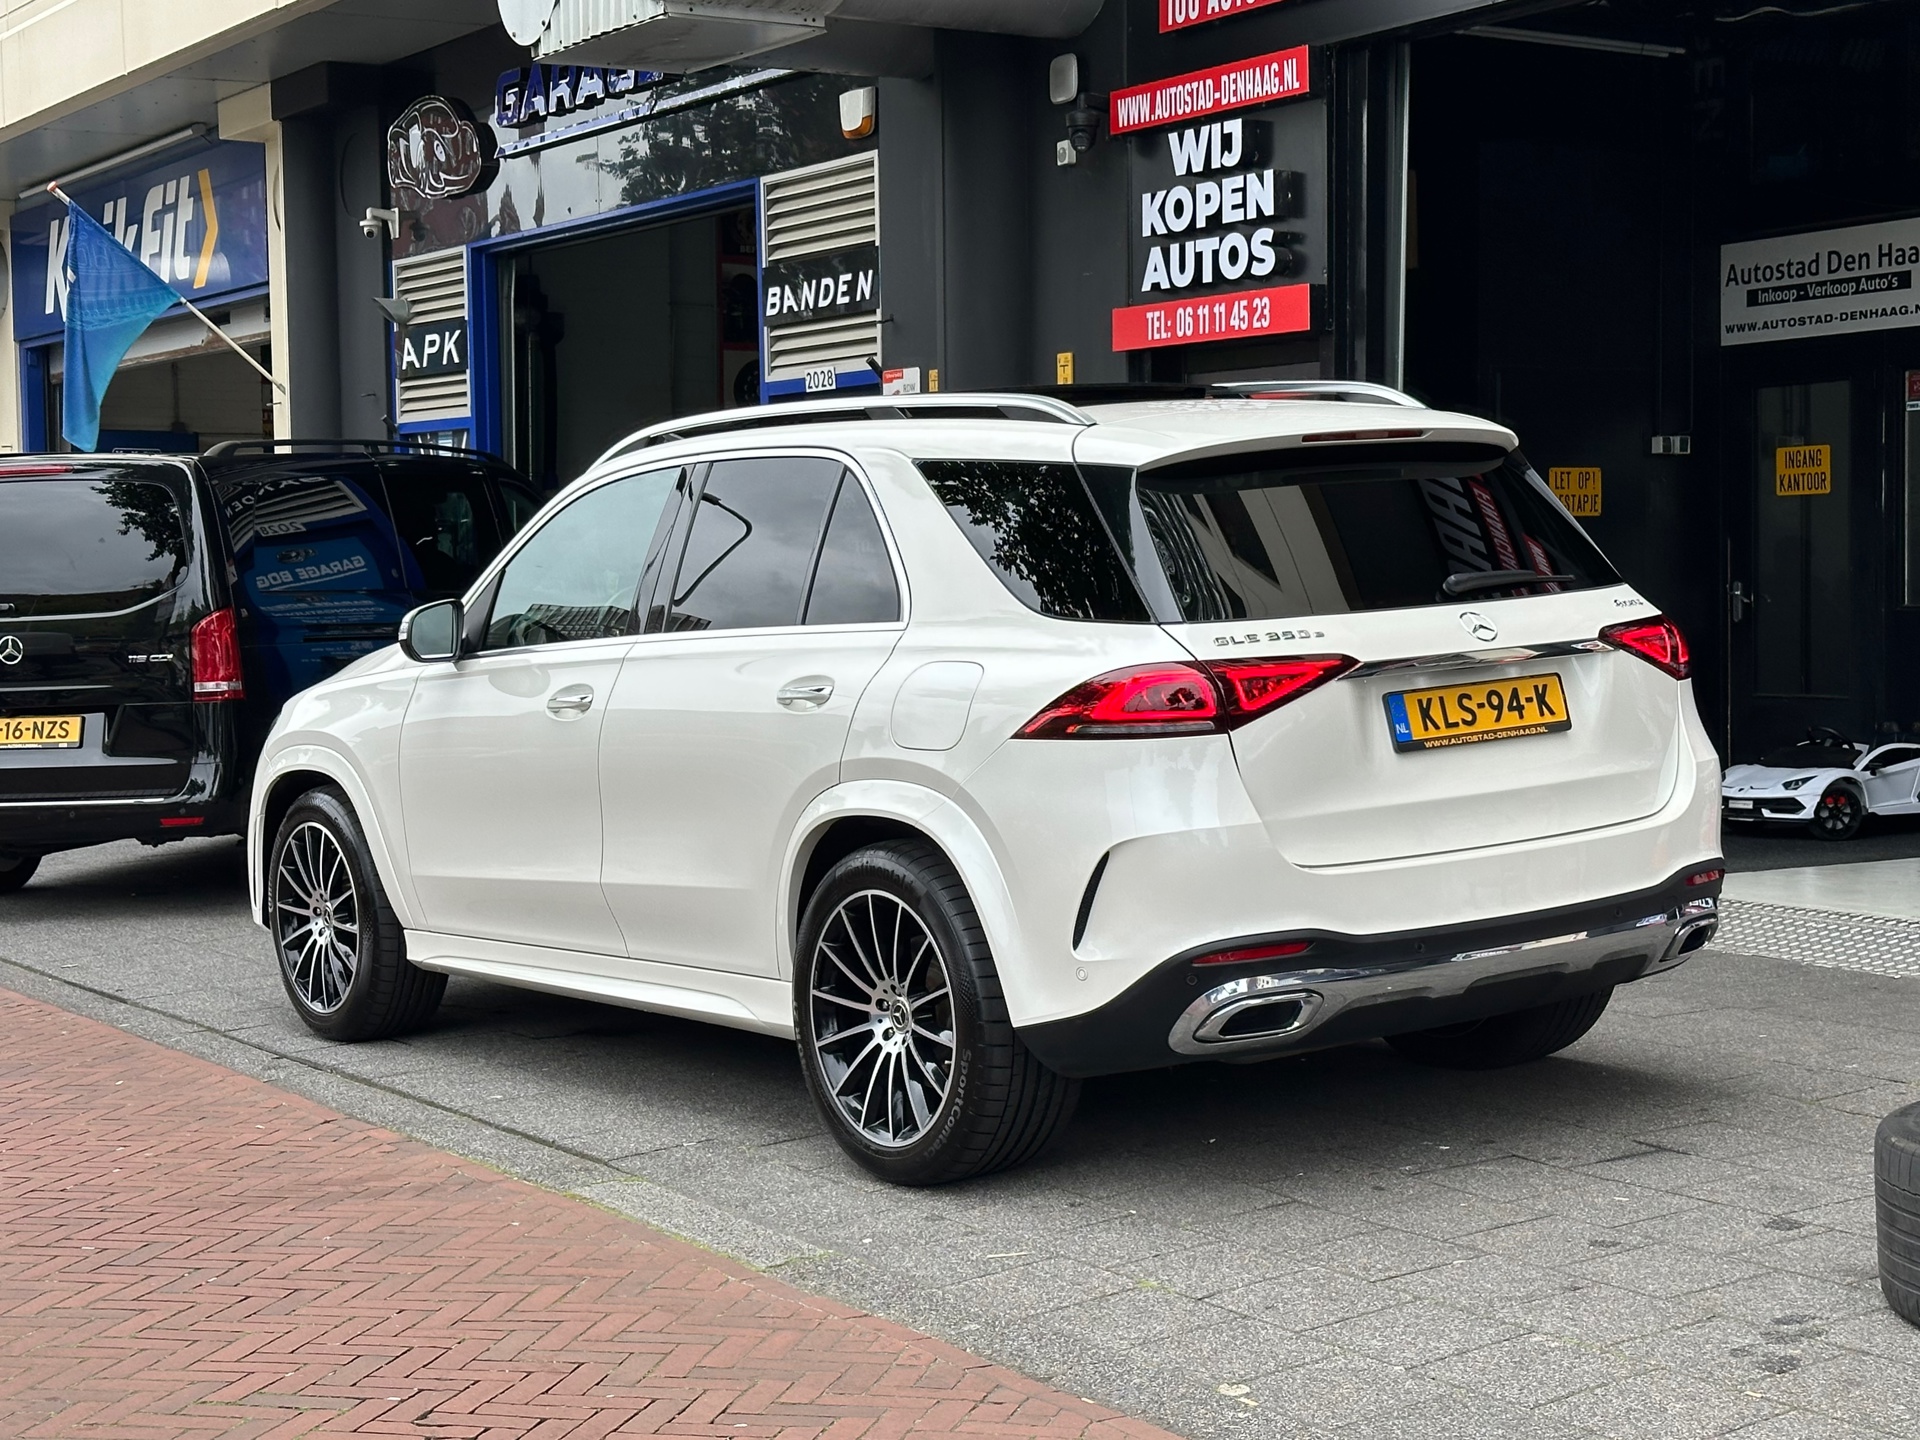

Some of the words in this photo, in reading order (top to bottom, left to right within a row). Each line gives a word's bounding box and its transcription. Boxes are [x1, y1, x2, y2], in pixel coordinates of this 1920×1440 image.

[1118, 58, 1300, 128] WWW.AUTOSTAD-DENHAAG.NL
[1168, 118, 1243, 176] WIJ
[1142, 169, 1275, 237] KOPEN
[1141, 228, 1276, 292] AUTOS
[1725, 252, 1820, 287] Autostad
[1827, 250, 1870, 275] Den
[766, 269, 873, 317] BANDEN
[1758, 289, 1797, 303] Inkoop
[1807, 281, 1856, 297] Verkoop
[1859, 275, 1898, 291] Auto's
[1146, 311, 1171, 341] TEL:
[1176, 307, 1193, 337] 06
[1197, 304, 1209, 335] 11
[1214, 302, 1226, 333] 11
[1230, 299, 1248, 331] 45
[1252, 296, 1270, 329] 23
[402, 330, 461, 370] APK
[806, 369, 834, 389] 2028
[1784, 449, 1822, 469] INGANG
[1554, 471, 1571, 490] LET
[1578, 471, 1596, 490] OP!
[1779, 471, 1827, 492] KANTOOR
[1213, 633, 1260, 646] GLE
[1417, 683, 1556, 732] KLS-94-K
[1396, 723, 1410, 734] NL
